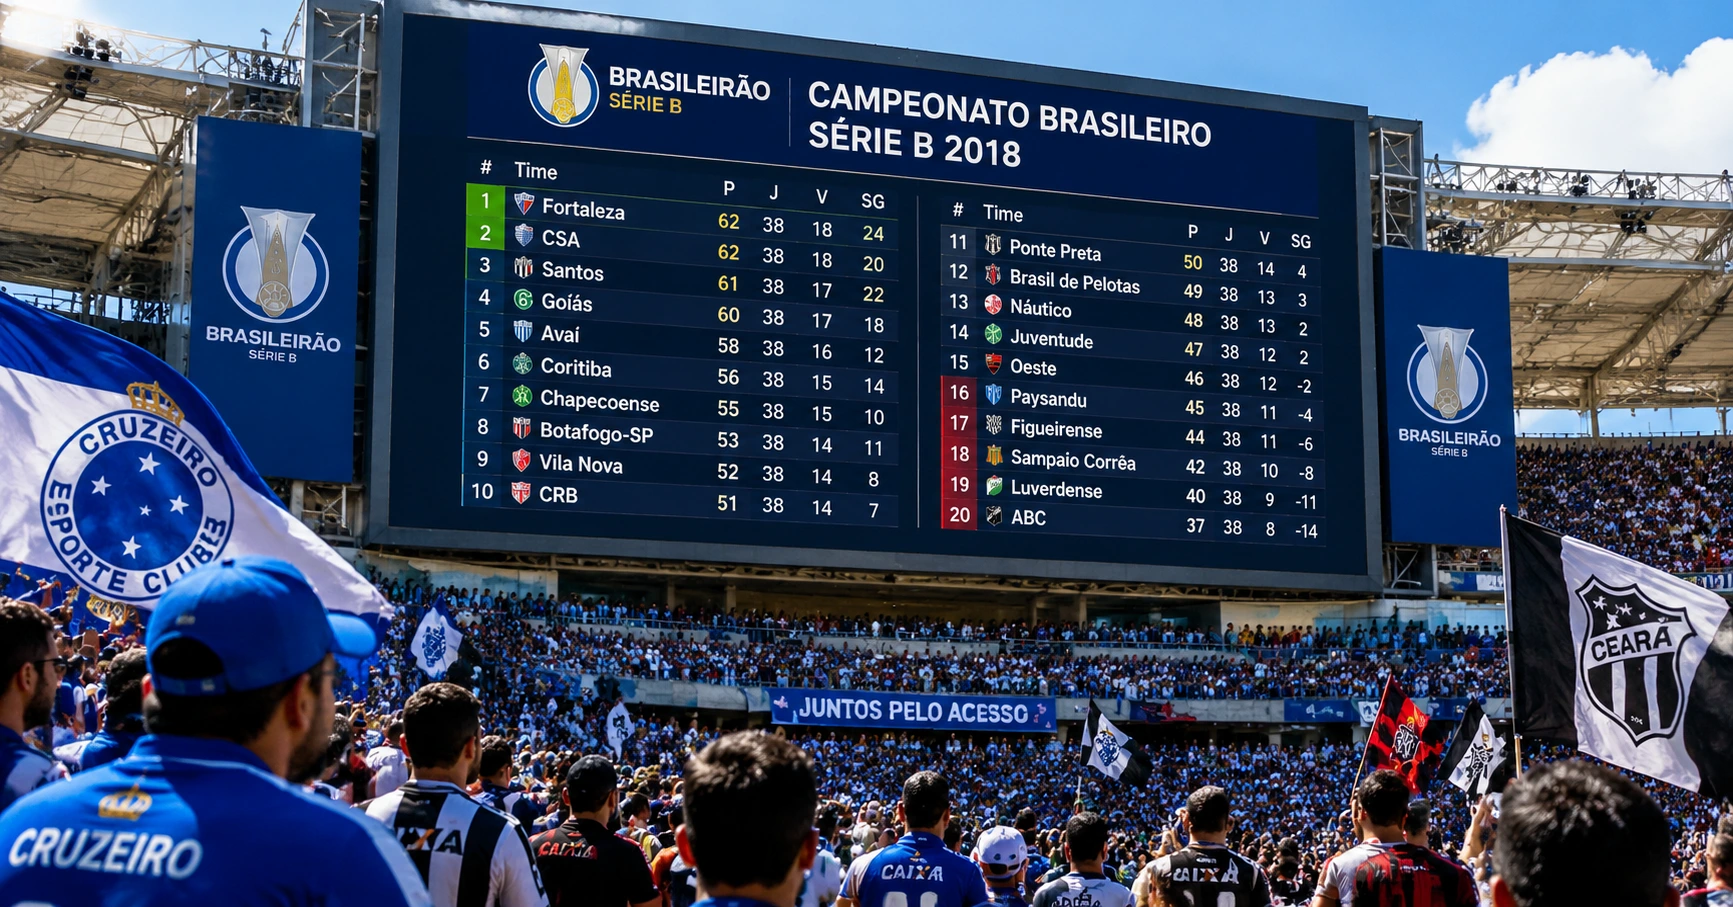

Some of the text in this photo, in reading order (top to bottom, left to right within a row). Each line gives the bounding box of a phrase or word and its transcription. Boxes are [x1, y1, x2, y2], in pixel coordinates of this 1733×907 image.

[609, 66, 771, 101] BRASILEIRÃO
[609, 90, 682, 114] SÉRIE B
[808, 80, 1212, 148] CAMPEONATO BRASILEIRO
[808, 116, 1021, 168] SÉRIE B 2018
[514, 161, 885, 210] Time P J V SG
[481, 191, 885, 242] 1 Fortaleza 62 38 18 24
[982, 203, 1312, 249] Time P J V SG
[479, 224, 885, 273] 2 CSA 62 18 20
[949, 233, 1307, 279] 11 Ponte Preta 50 38 14 4
[479, 256, 884, 303] 3 Santos 61 38 17 22
[949, 262, 1307, 308] 12 Brasil de Pelotas 49 13 3
[478, 288, 491, 306] 4
[717, 306, 740, 323] 60
[812, 312, 833, 329] 17
[864, 316, 885, 334] 18
[949, 293, 1308, 337] 13 Náutico 48 38 13 2
[205, 325, 341, 352] BRASILEIRÃO
[248, 347, 297, 364] SÉRIE B
[479, 320, 884, 364] 5 Avaí 58 38 16 12
[949, 323, 1309, 365] 14 Juventude 47 12 2
[478, 352, 885, 395] 6 Coritiba 56 15 14
[950, 353, 1312, 394] 15 Oeste 46 38 12 -2
[478, 385, 885, 426] 7 Chapecoense 55 38 15 10
[950, 384, 1313, 423] 16 Paysandu 45 11 -4
[79, 416, 217, 487] CRUZEIRO
[477, 417, 882, 457] 8 Botafogo-SP 53 14 11
[950, 414, 1314, 452] 17 Figueirense 44 38 11 -6
[1398, 427, 1501, 448] BRASILEIRÃO
[1431, 445, 1468, 458] SÉRIE B
[477, 450, 880, 488] 9 Vila Nova 52 38 14 8
[950, 445, 970, 462] 18
[1011, 448, 1080, 470] Sampaio
[1185, 458, 1206, 475] 42
[1260, 462, 1279, 479] 10
[1299, 465, 1314, 481] -8
[471, 482, 879, 519] 10 CRB 51 14 7
[950, 475, 1316, 510] 19 Luverdense 40 38 9 -11
[949, 506, 1318, 539] 20 ABC 37 38 8 -14
[799, 696, 1029, 724] JUNTOS PELO ACESSO
[8, 827, 203, 880] CRUZEIRO
